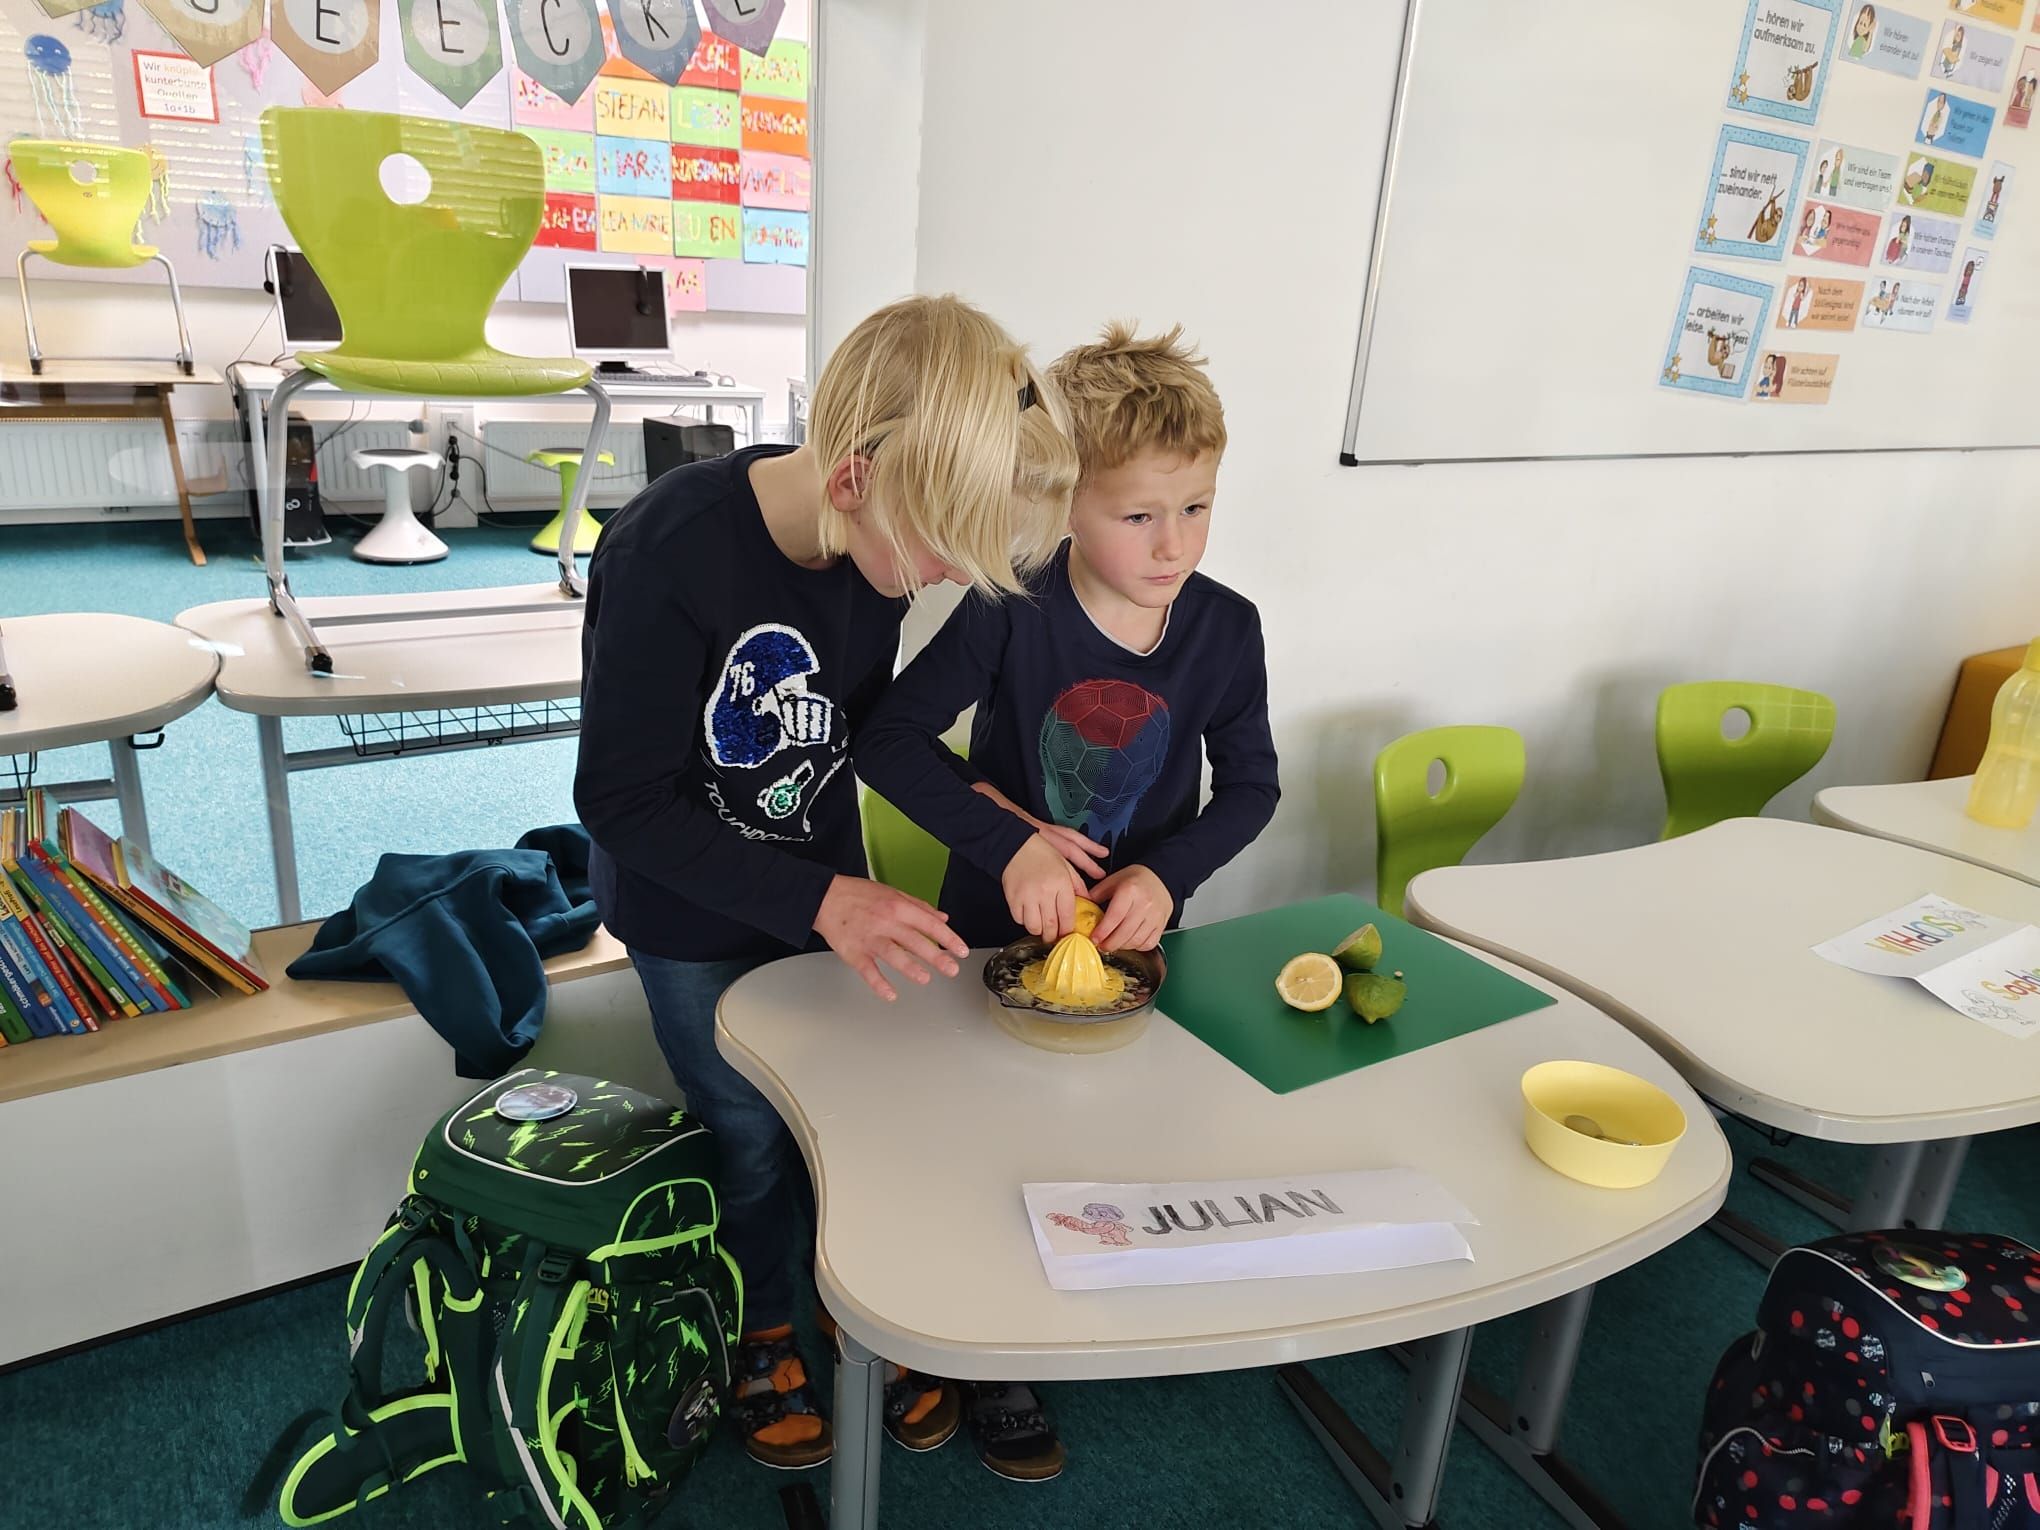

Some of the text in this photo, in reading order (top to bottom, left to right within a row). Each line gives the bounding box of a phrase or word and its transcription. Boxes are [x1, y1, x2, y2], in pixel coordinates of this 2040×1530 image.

[1765, 10, 1790, 29] hören
[1790, 19, 1804, 33] wir
[1754, 28, 1816, 54] aufmerksam zu.
[143, 61, 161, 71] Wir
[598, 90, 665, 122] STEFAN
[1730, 165, 1748, 180] sind
[1747, 169, 1760, 182] wir
[1718, 183, 1762, 200] zueinander.
[1697, 307, 1730, 323] arbeiten
[1731, 313, 1745, 326] wir
[729, 661, 756, 703] 76
[1141, 1188, 1344, 1236] JULIAN
